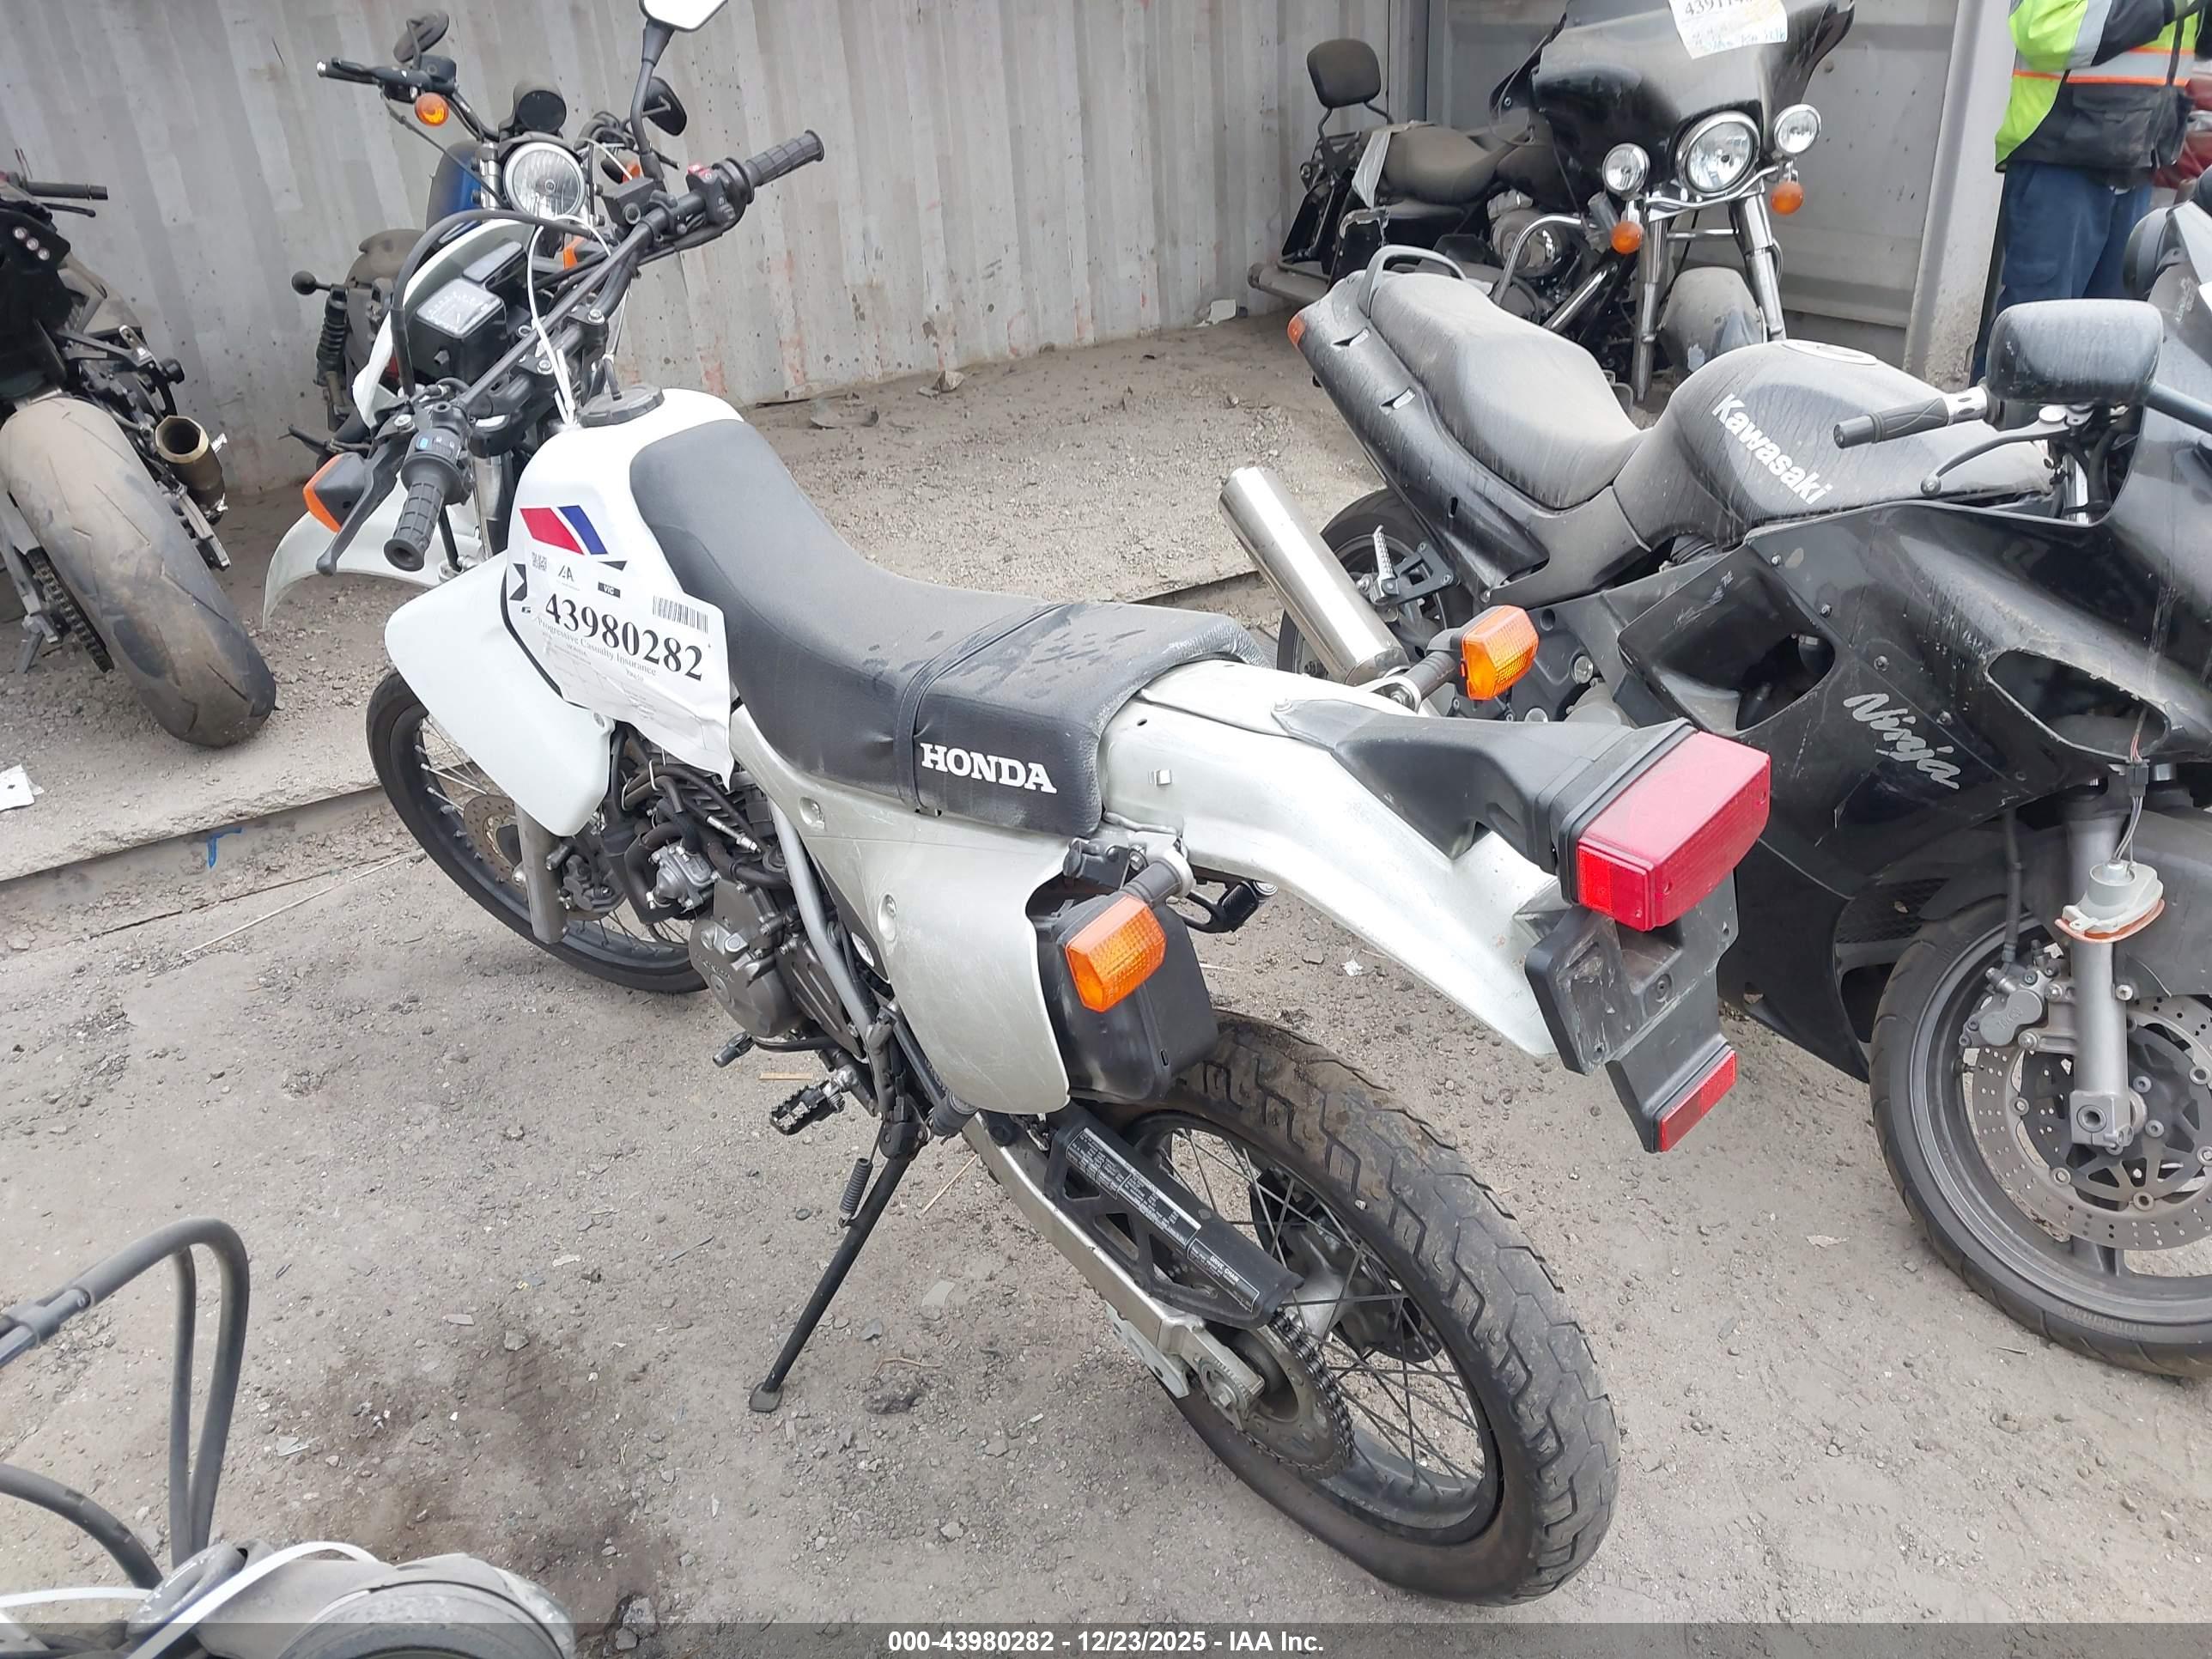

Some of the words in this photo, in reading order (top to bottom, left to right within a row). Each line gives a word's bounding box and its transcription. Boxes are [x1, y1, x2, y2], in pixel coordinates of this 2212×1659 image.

[1711, 392, 1833, 505] Kawasaki
[545, 593, 702, 681] 43980282
[580, 638, 614, 661] Casualty
[617, 653, 657, 676] Insurance
[920, 743, 1057, 793] HONDA
[1843, 693, 1961, 790] Ninja
[1210, 1255, 1224, 1270] DRIVE
[1224, 1267, 1239, 1283] CHAIN
